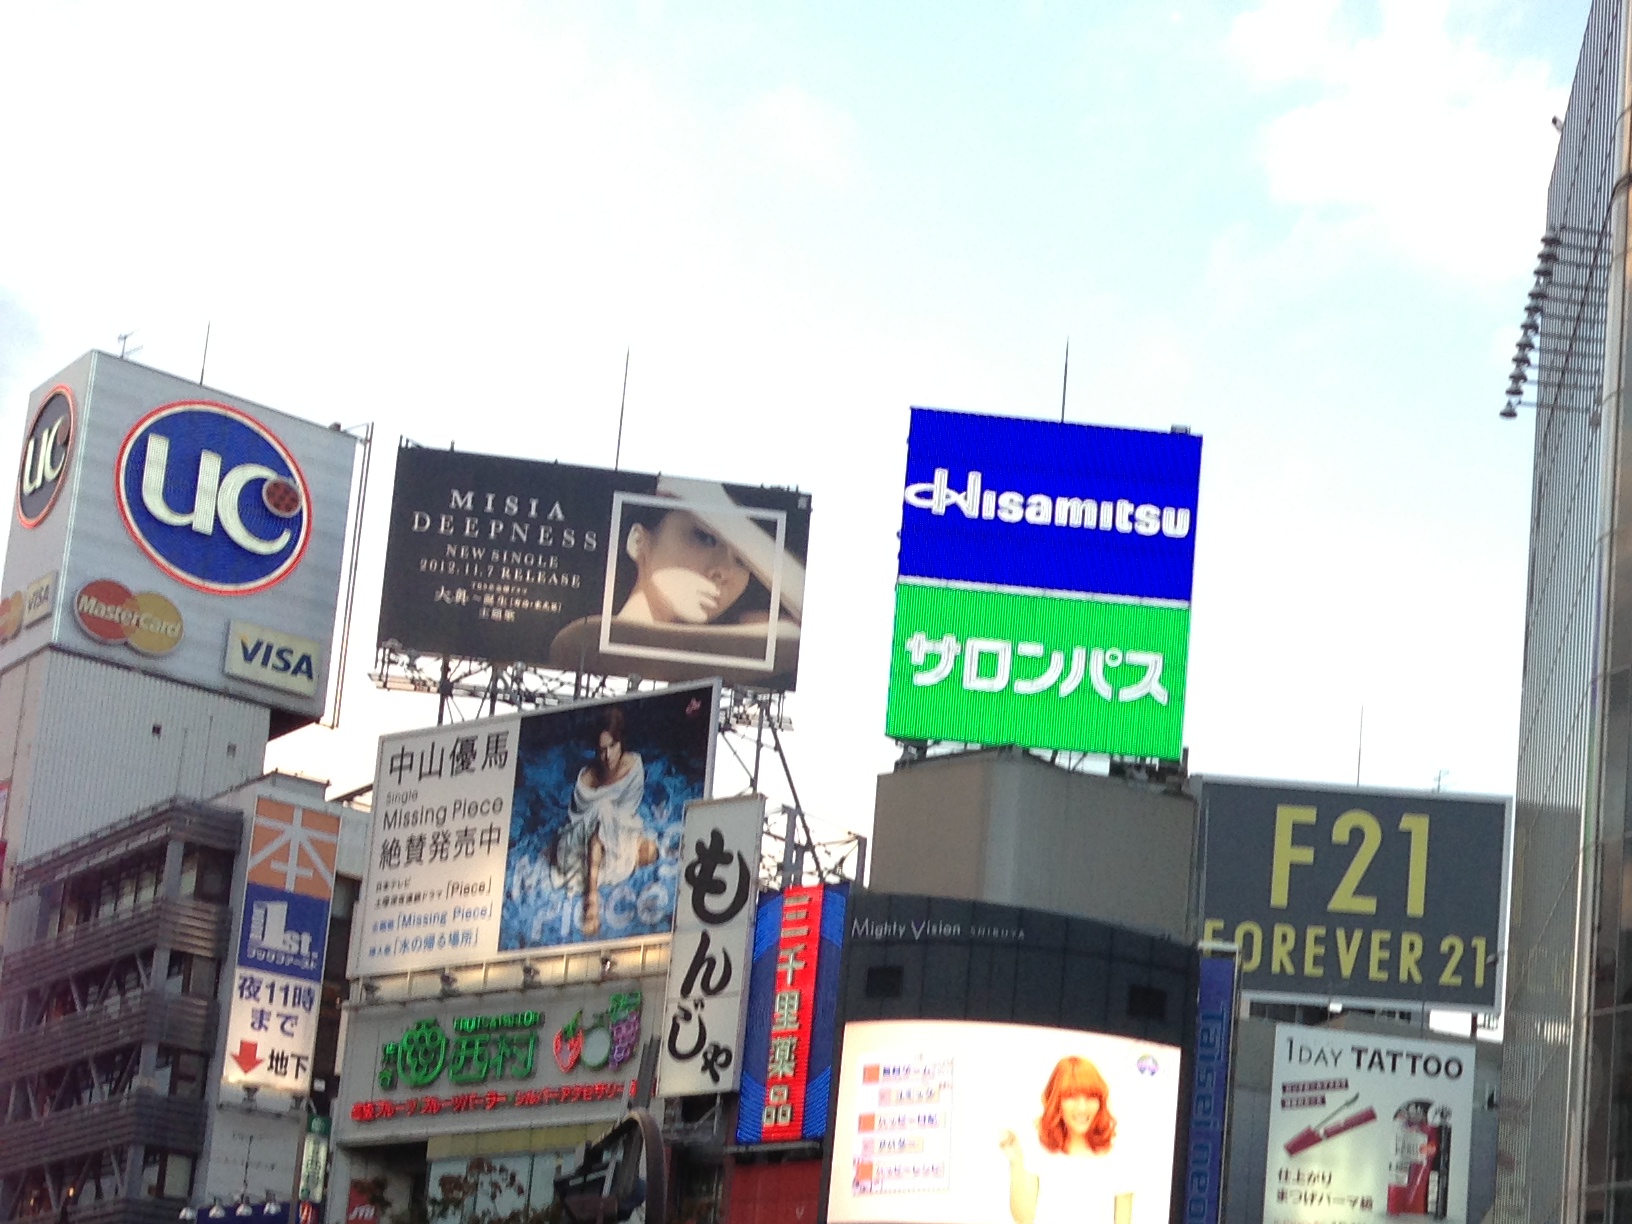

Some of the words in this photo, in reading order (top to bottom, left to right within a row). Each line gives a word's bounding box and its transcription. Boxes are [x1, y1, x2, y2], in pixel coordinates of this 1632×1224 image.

[450, 488, 567, 522] MISIA
[904, 467, 1191, 538] Hisamitsu
[412, 510, 599, 552] DEEPNESS
[419, 556, 494, 577] 2012.11.7
[501, 566, 582, 590] RELEASE
[446, 543, 486, 561] NEW
[491, 548, 560, 570] SINGLE
[26, 584, 50, 614] VISA
[238, 633, 315, 681] VISA
[905, 631, 1169, 707] サロンパス
[387, 730, 510, 786] 中山優馬
[382, 803, 447, 832] Missing
[451, 796, 504, 824] Piece
[386, 788, 418, 807] Single
[378, 823, 502, 870] 絶賛発売中
[1270, 803, 1430, 918] F21
[851, 917, 906, 940] Mighty
[911, 919, 961, 941] Vision
[970, 926, 1025, 940] SHIBUYA
[667, 828, 751, 1084] もんじゃ
[1202, 918, 1423, 984] FOREVER
[1438, 935, 1487, 988] 21
[238, 973, 316, 1013] 夜11時
[762, 894, 811, 1127] 三千里薬品
[250, 1008, 299, 1038] まで
[266, 1047, 310, 1078] 地下
[448, 1030, 538, 1083] 西村
[1351, 1044, 1464, 1081] TATTOO
